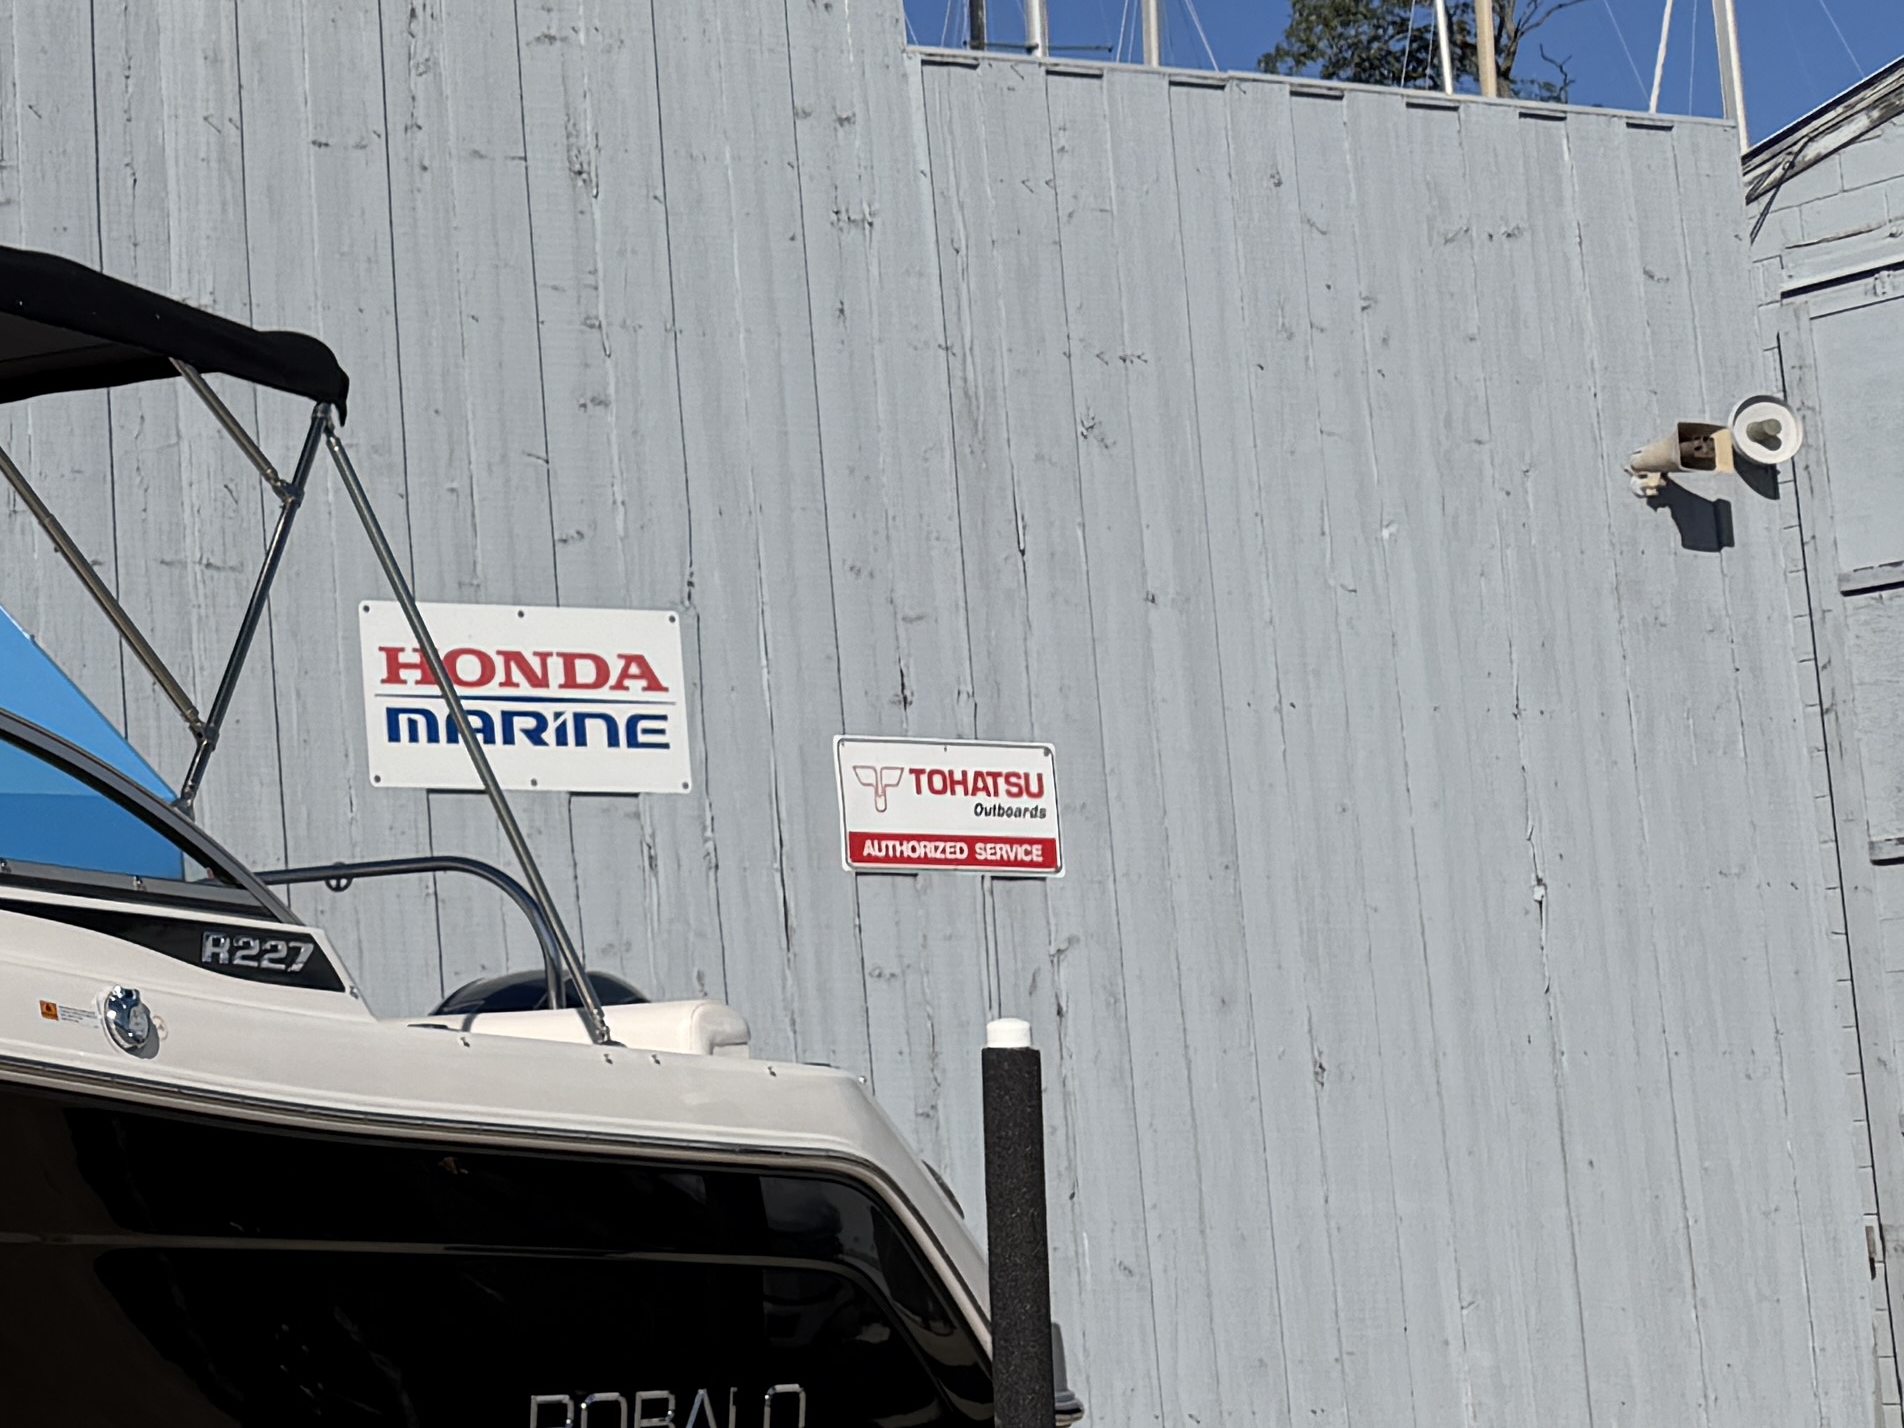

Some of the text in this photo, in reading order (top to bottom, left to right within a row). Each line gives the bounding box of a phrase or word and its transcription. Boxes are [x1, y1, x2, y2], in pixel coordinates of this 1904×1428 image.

[379, 645, 669, 692] HONDA
[909, 767, 1045, 799] TOHATSU
[973, 801, 1047, 820] Outboards
[863, 837, 1043, 863] AUTHORIZED SERVICE
[201, 931, 314, 972] R227
